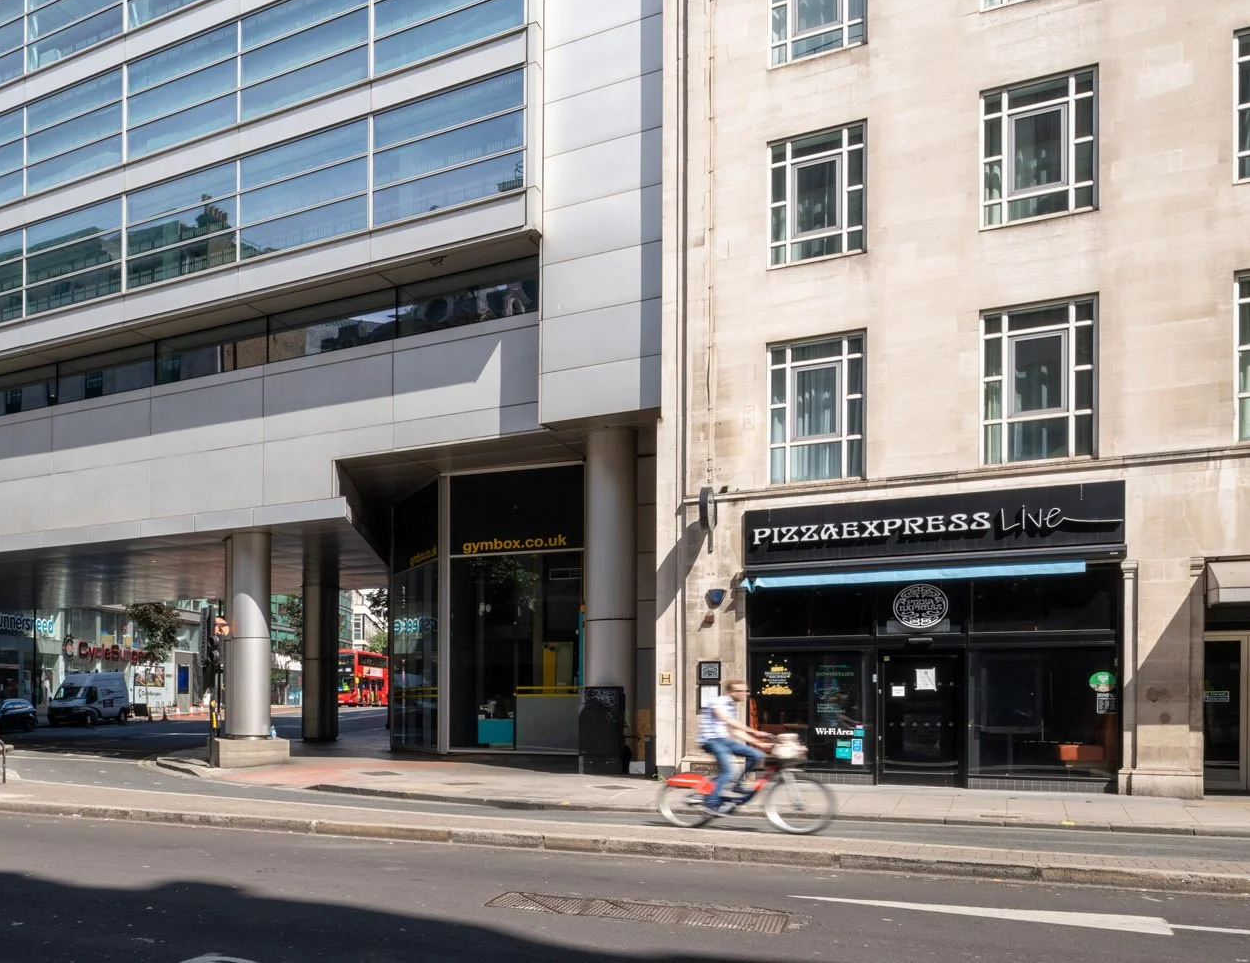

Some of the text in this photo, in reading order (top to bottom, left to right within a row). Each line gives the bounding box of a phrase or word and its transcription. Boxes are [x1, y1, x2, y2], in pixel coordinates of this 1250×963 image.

[752, 512, 992, 545] PIZZAEXPRESS
[462, 534, 567, 554] gymbox.co.uk
[661, 673, 671, 683] H
[815, 727, 854, 736] Wi-Fi Area
